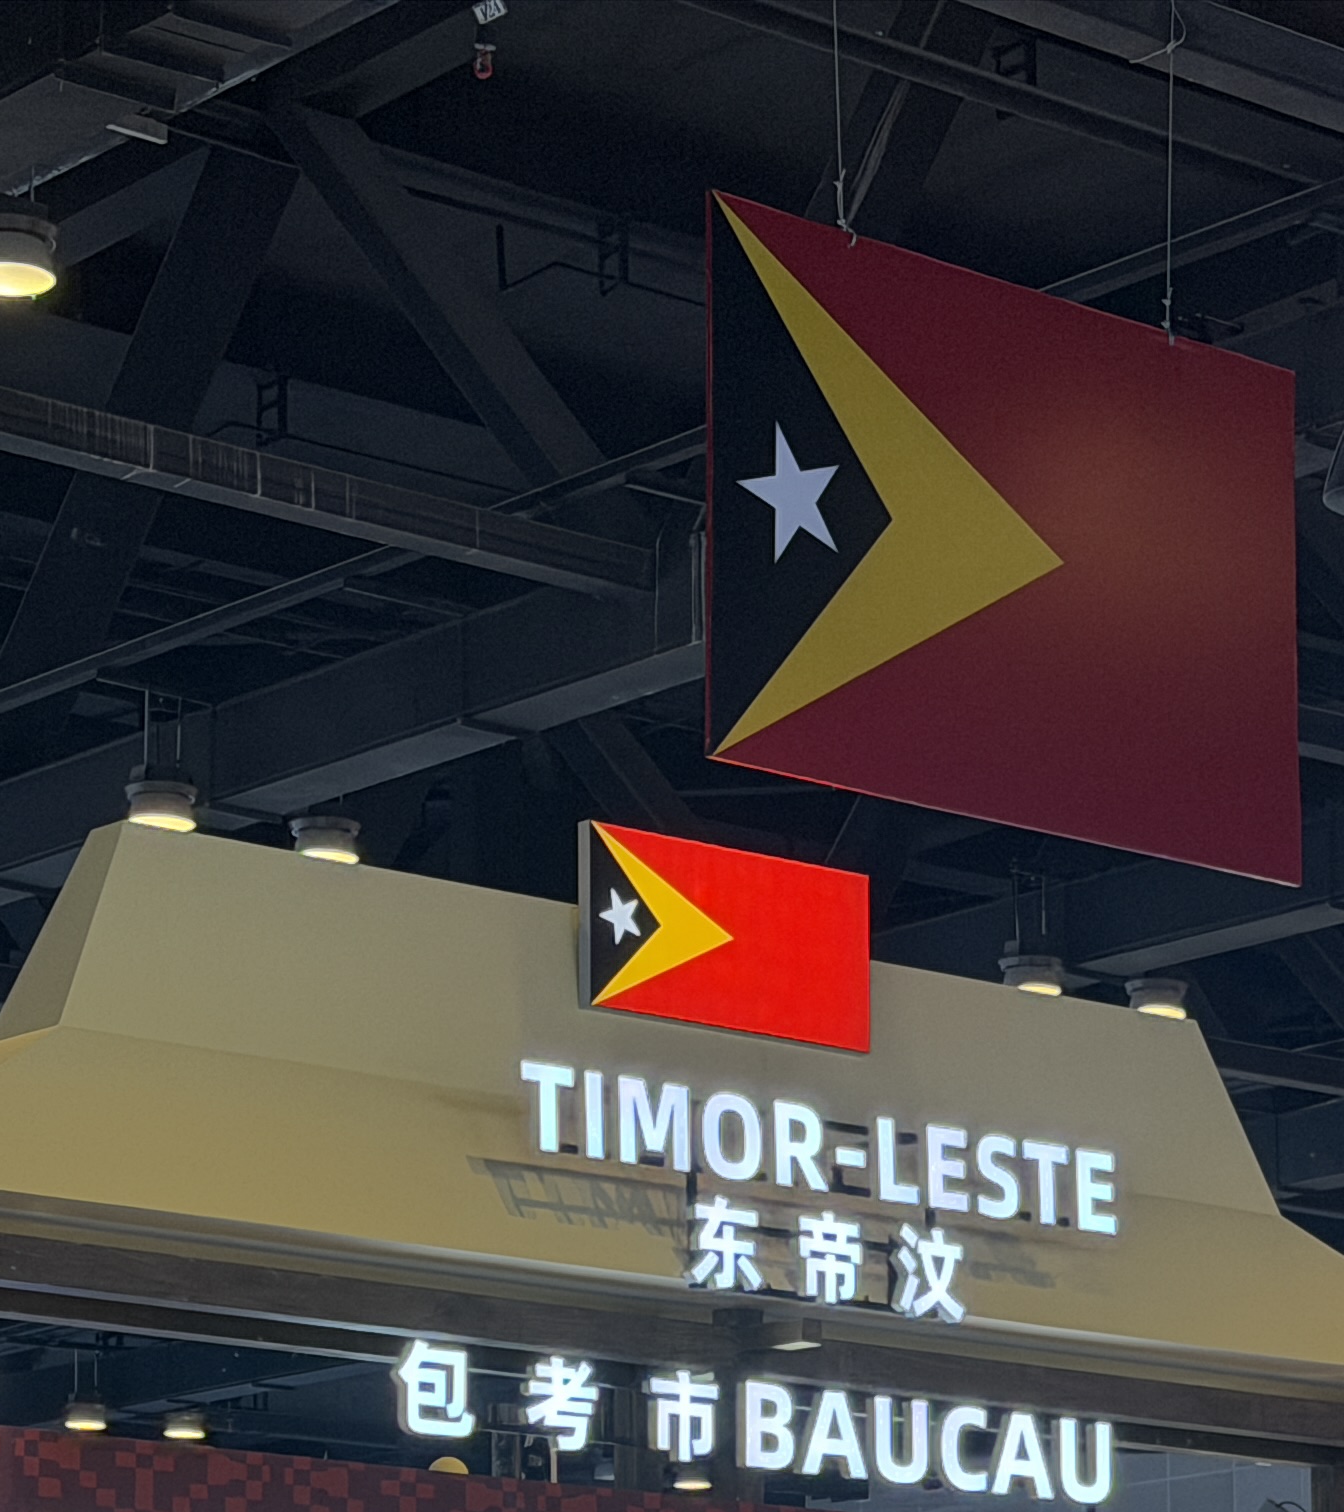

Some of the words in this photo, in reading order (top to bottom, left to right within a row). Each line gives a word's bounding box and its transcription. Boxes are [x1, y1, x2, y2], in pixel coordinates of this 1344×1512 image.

[520, 1060, 1118, 1236] TIMOR-LESTE
[685, 1196, 966, 1324] 东帝汶
[397, 1340, 720, 1464] 包考市
[738, 1376, 1114, 1506] BAUCAU
